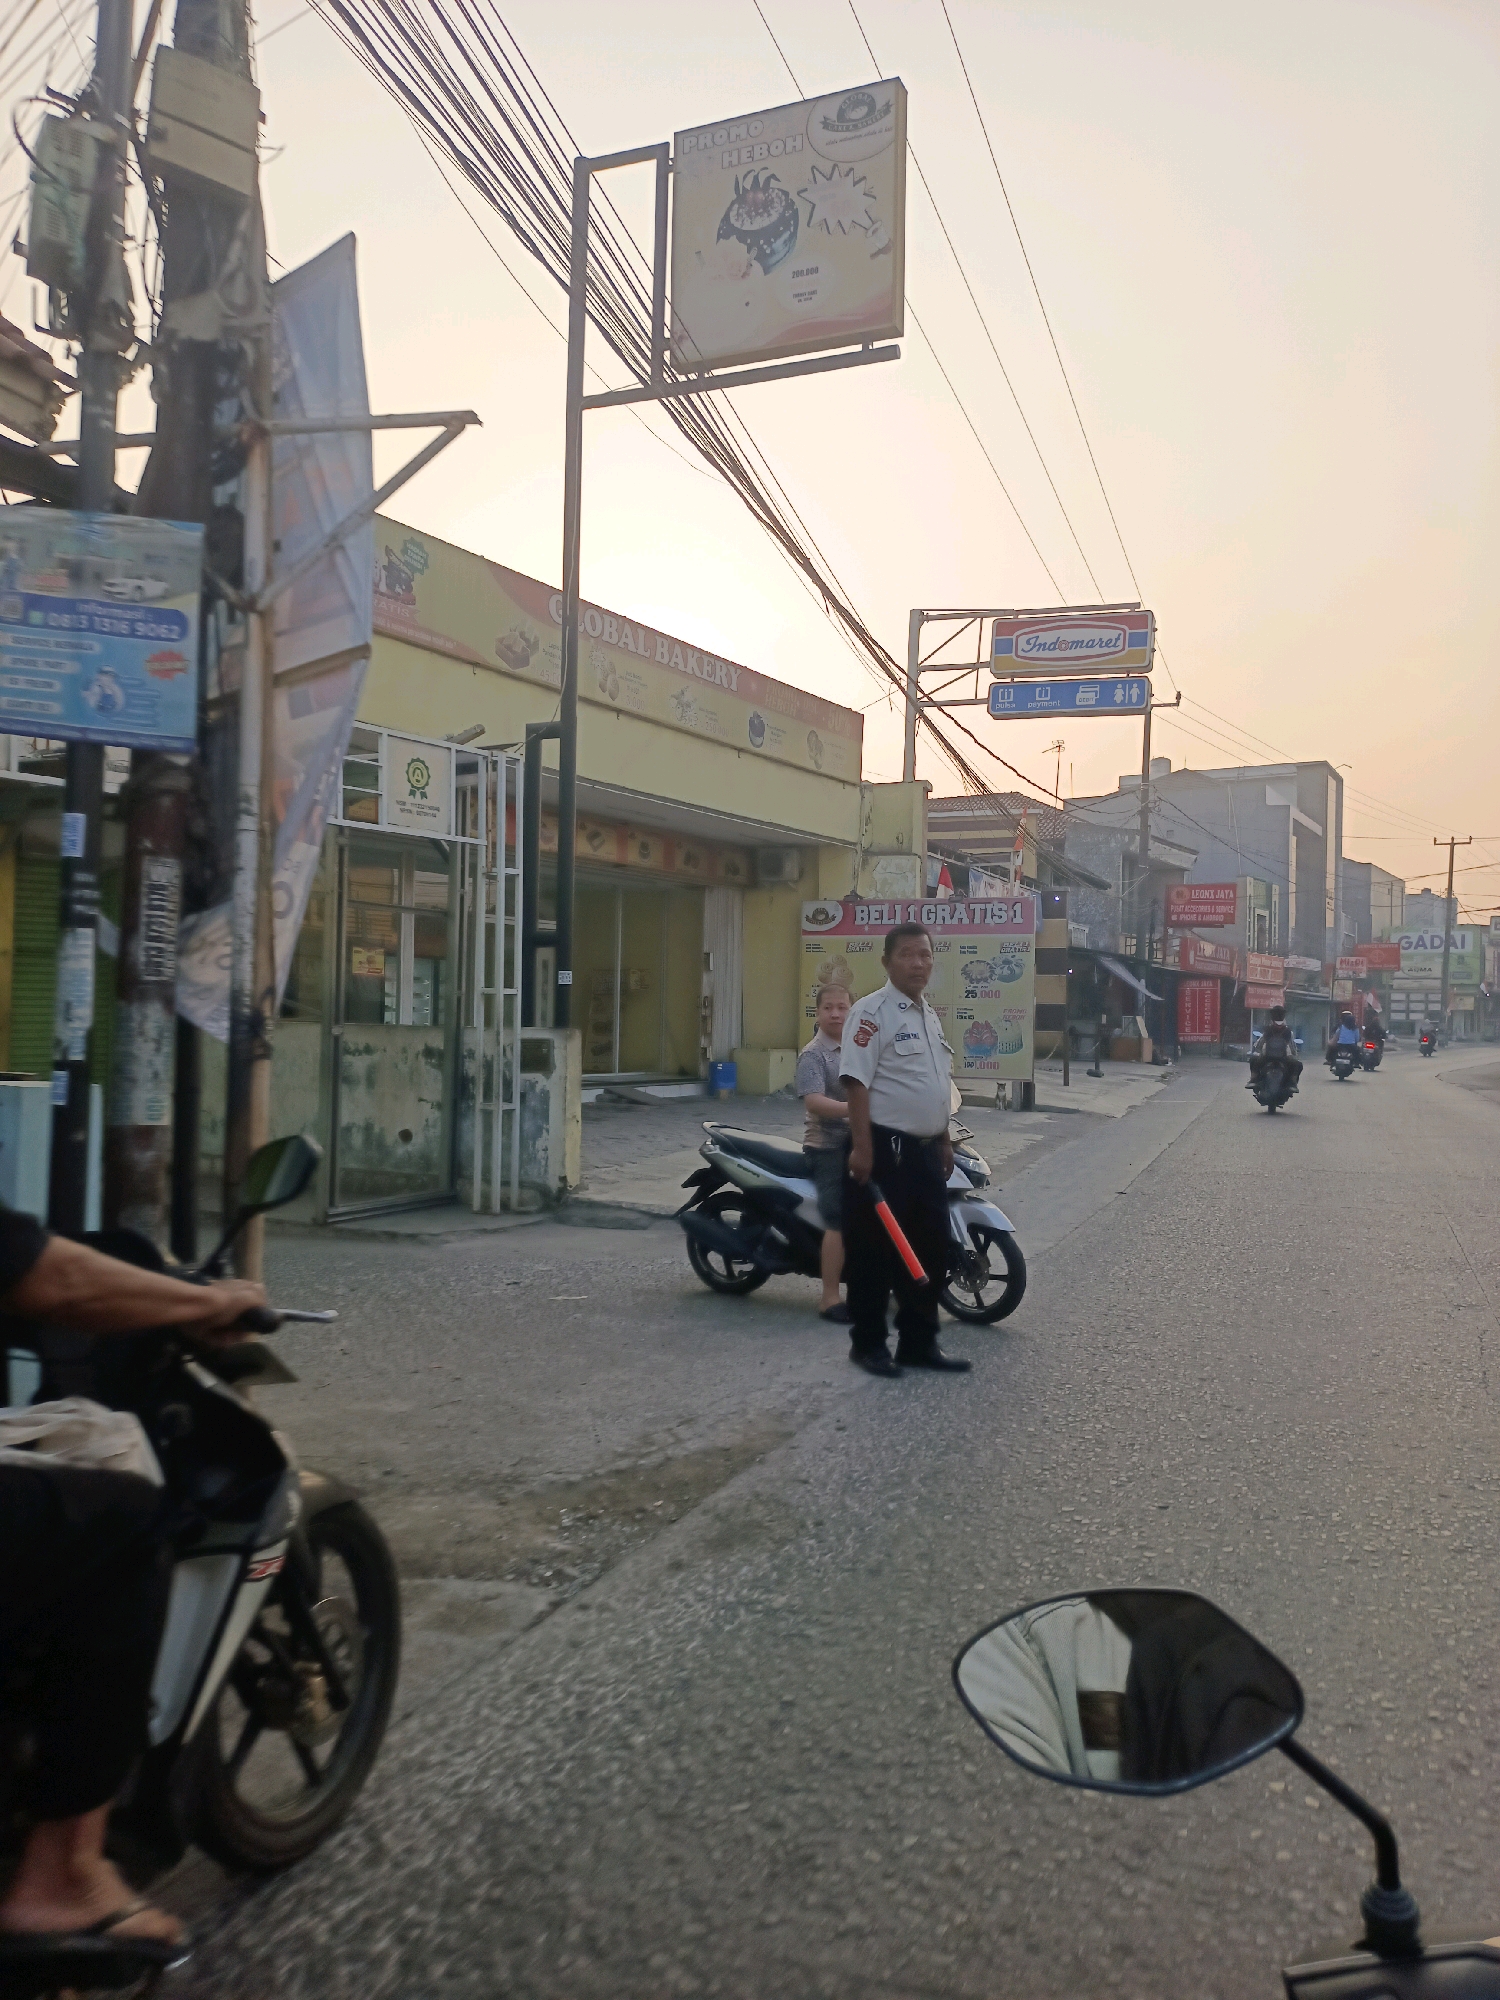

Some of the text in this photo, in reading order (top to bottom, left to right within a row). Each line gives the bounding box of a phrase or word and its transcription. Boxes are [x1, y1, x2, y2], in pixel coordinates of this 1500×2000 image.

[841, 93, 872, 109] GLOBAL
[683, 120, 764, 155] PROMO
[722, 134, 803, 169] HEBOH
[791, 266, 819, 279] 200.000
[375, 600, 410, 618] ATIS
[549, 594, 650, 659] GOBAL
[655, 634, 742, 692] BAKERY
[1021, 632, 1122, 653] Indomaret
[995, 701, 1016, 709] pulsa
[1027, 699, 1061, 709] payment
[1191, 889, 1234, 900] LEONX JAYA
[855, 903, 902, 925] BELI
[907, 904, 917, 924] 1
[921, 902, 1009, 925] GRATIS
[1013, 902, 1024, 924] 1
[1398, 933, 1466, 951] GADAI
[964, 990, 1001, 999] 25.000
